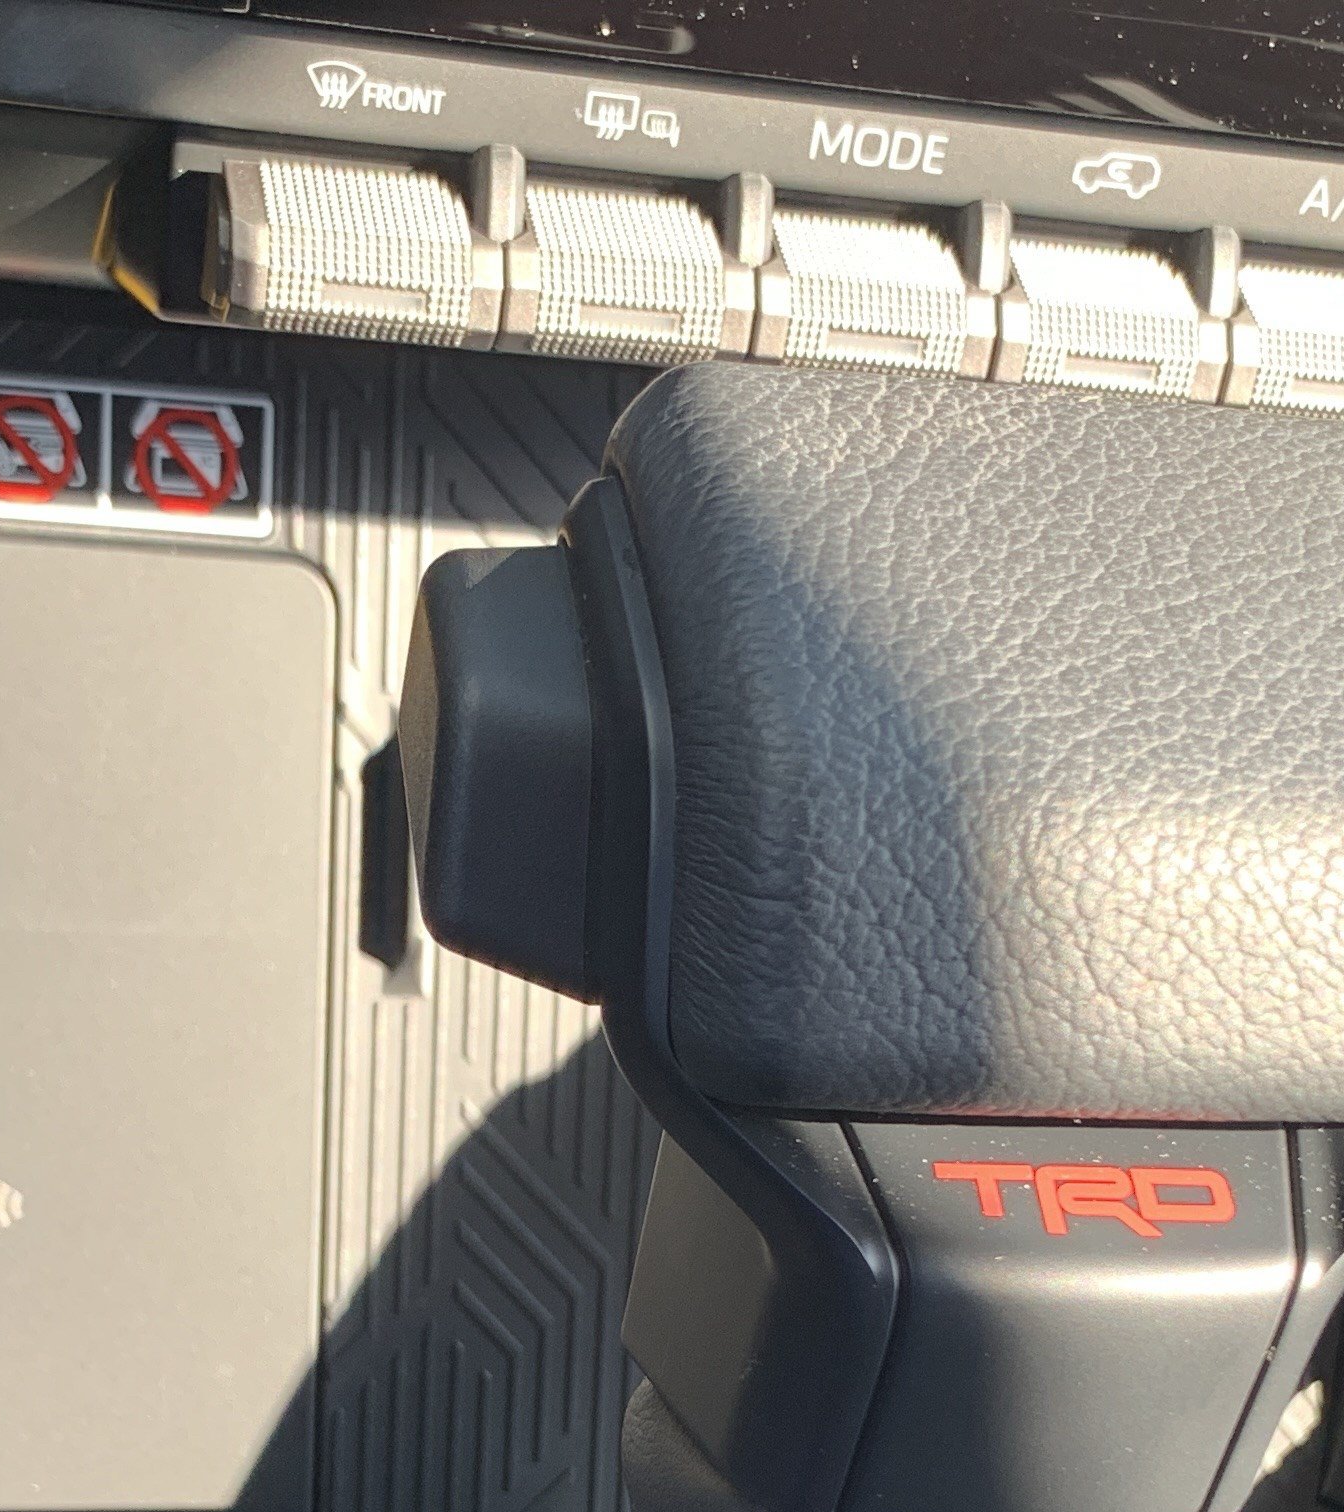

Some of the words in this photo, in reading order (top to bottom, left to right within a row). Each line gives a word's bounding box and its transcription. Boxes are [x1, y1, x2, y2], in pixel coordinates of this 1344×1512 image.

[361, 80, 447, 116] FRONT
[807, 119, 950, 176] MODE
[932, 1160, 1236, 1239] TRD
